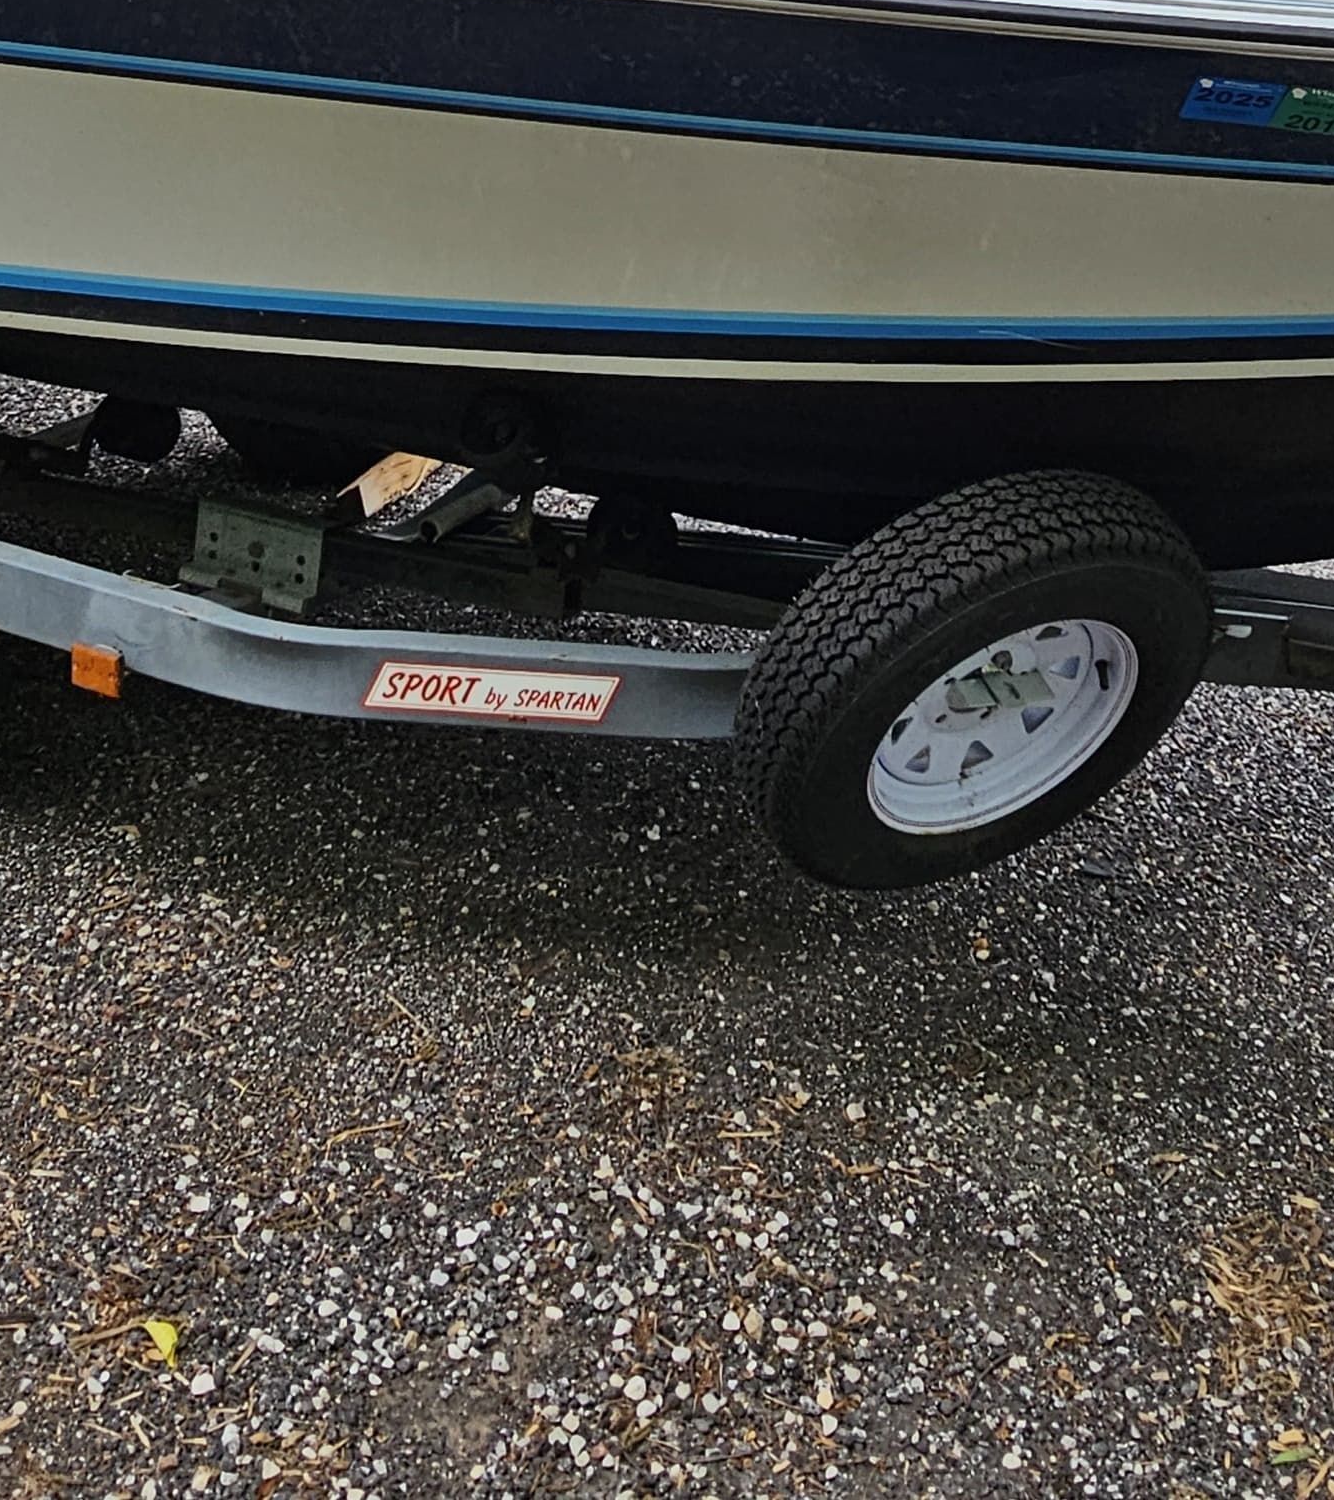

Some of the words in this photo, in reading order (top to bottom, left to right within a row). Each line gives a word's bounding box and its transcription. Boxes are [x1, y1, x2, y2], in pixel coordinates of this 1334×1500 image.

[382, 671, 482, 705] SPORT
[484, 686, 509, 711] by
[513, 688, 603, 713] SPARTAN
